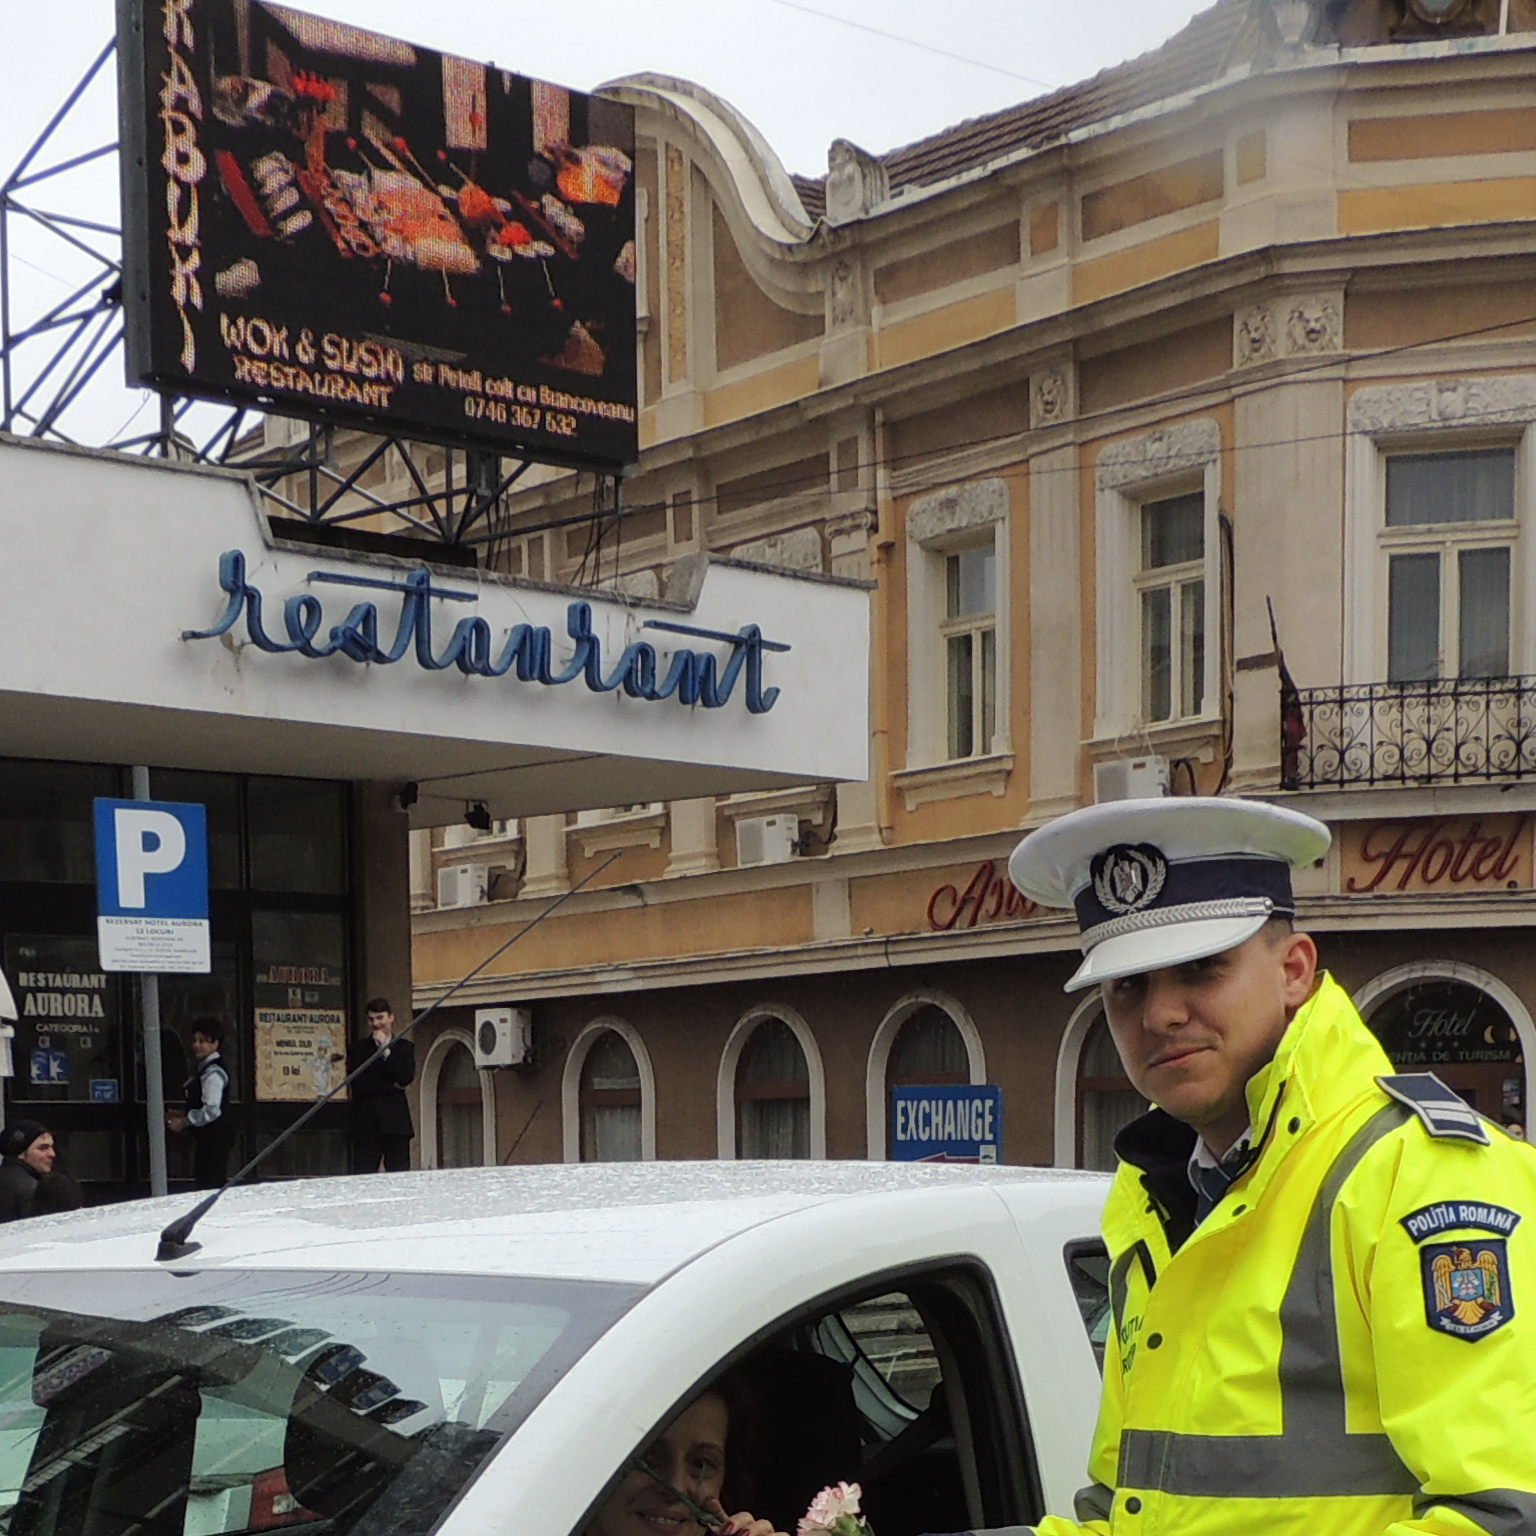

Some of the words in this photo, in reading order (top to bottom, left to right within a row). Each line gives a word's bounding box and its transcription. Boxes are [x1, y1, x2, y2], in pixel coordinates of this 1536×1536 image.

[220, 311, 290, 361] WOK
[295, 327, 317, 365] &
[232, 353, 394, 409] RESTAURANT
[182, 550, 790, 715] restaurant
[114, 808, 186, 909] P
[1346, 814, 1526, 893] Hotel
[18, 972, 107, 989] RESTAURANT
[23, 992, 106, 1018] AURORA
[259, 1011, 307, 1024] RESTAURANT
[309, 1013, 342, 1025] AURORA
[1408, 1008, 1478, 1038] Hotel
[1432, 1050, 1451, 1062] DE
[1459, 1049, 1511, 1062] TURISM
[896, 1098, 994, 1142] EXCHANGE
